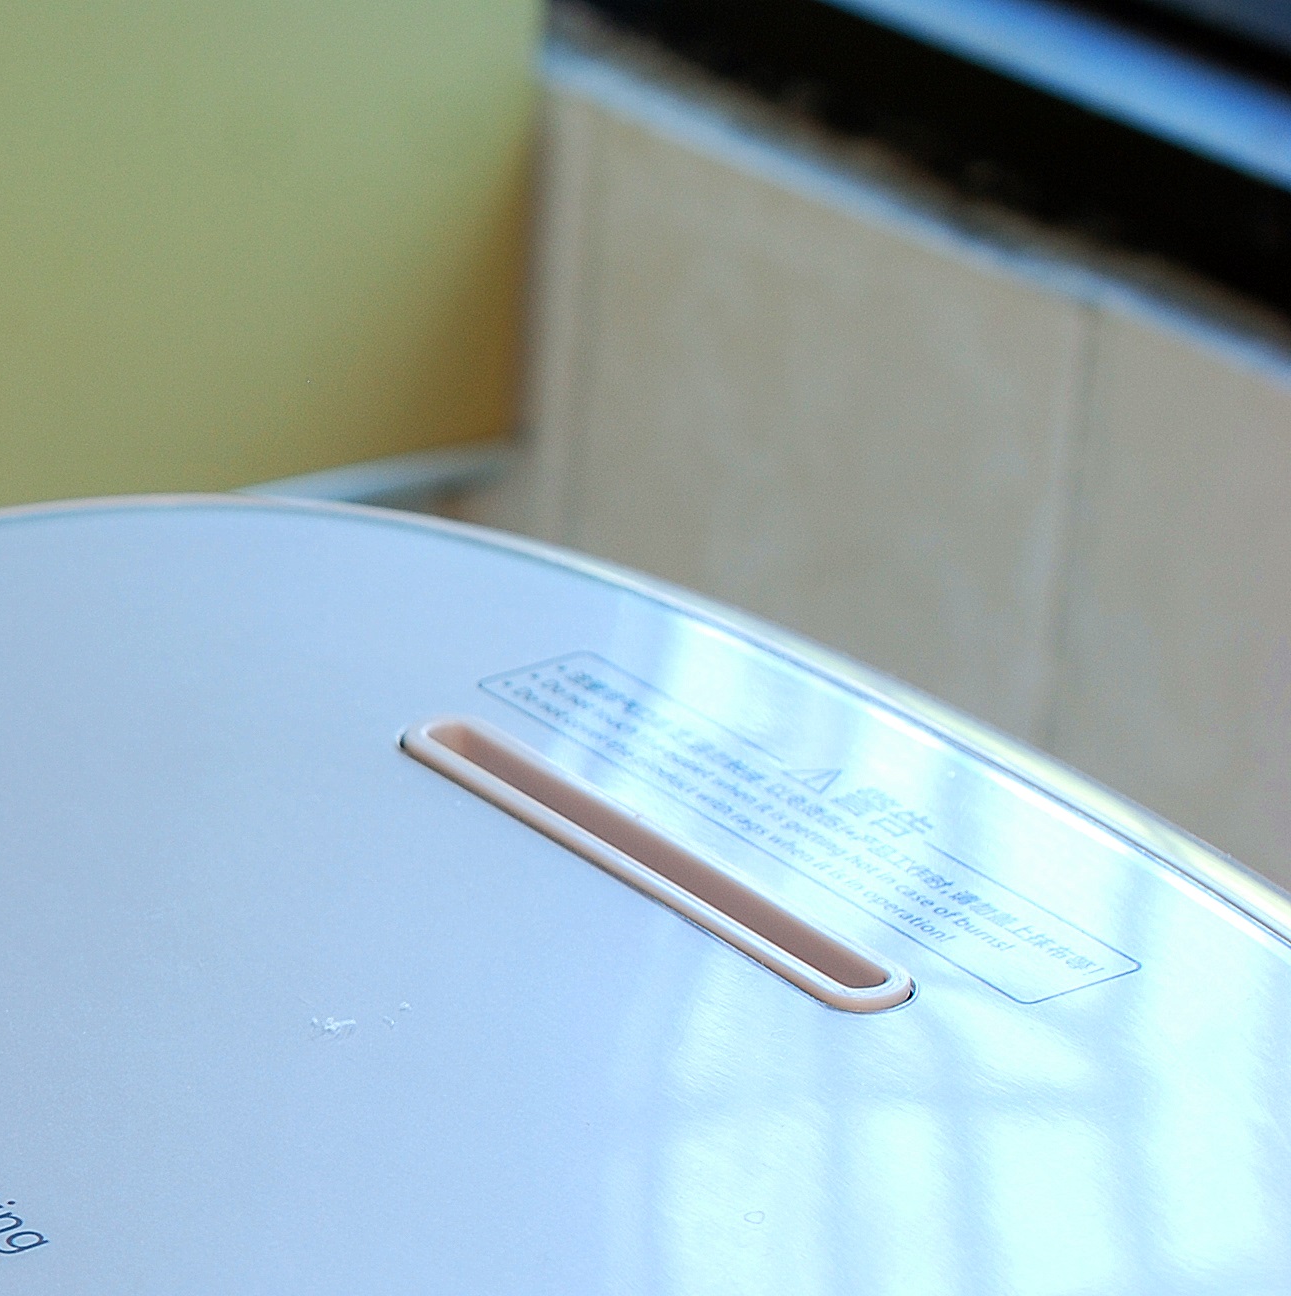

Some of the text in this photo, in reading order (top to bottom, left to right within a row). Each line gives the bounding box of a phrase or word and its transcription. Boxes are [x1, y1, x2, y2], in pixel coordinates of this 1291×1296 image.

[830, 787, 934, 837] 警告
[841, 877, 871, 891] in
[873, 870, 904, 885] in
[892, 883, 938, 907] case
[929, 903, 964, 920] of
[951, 916, 1019, 952] burns!
[854, 887, 960, 945] operation!
